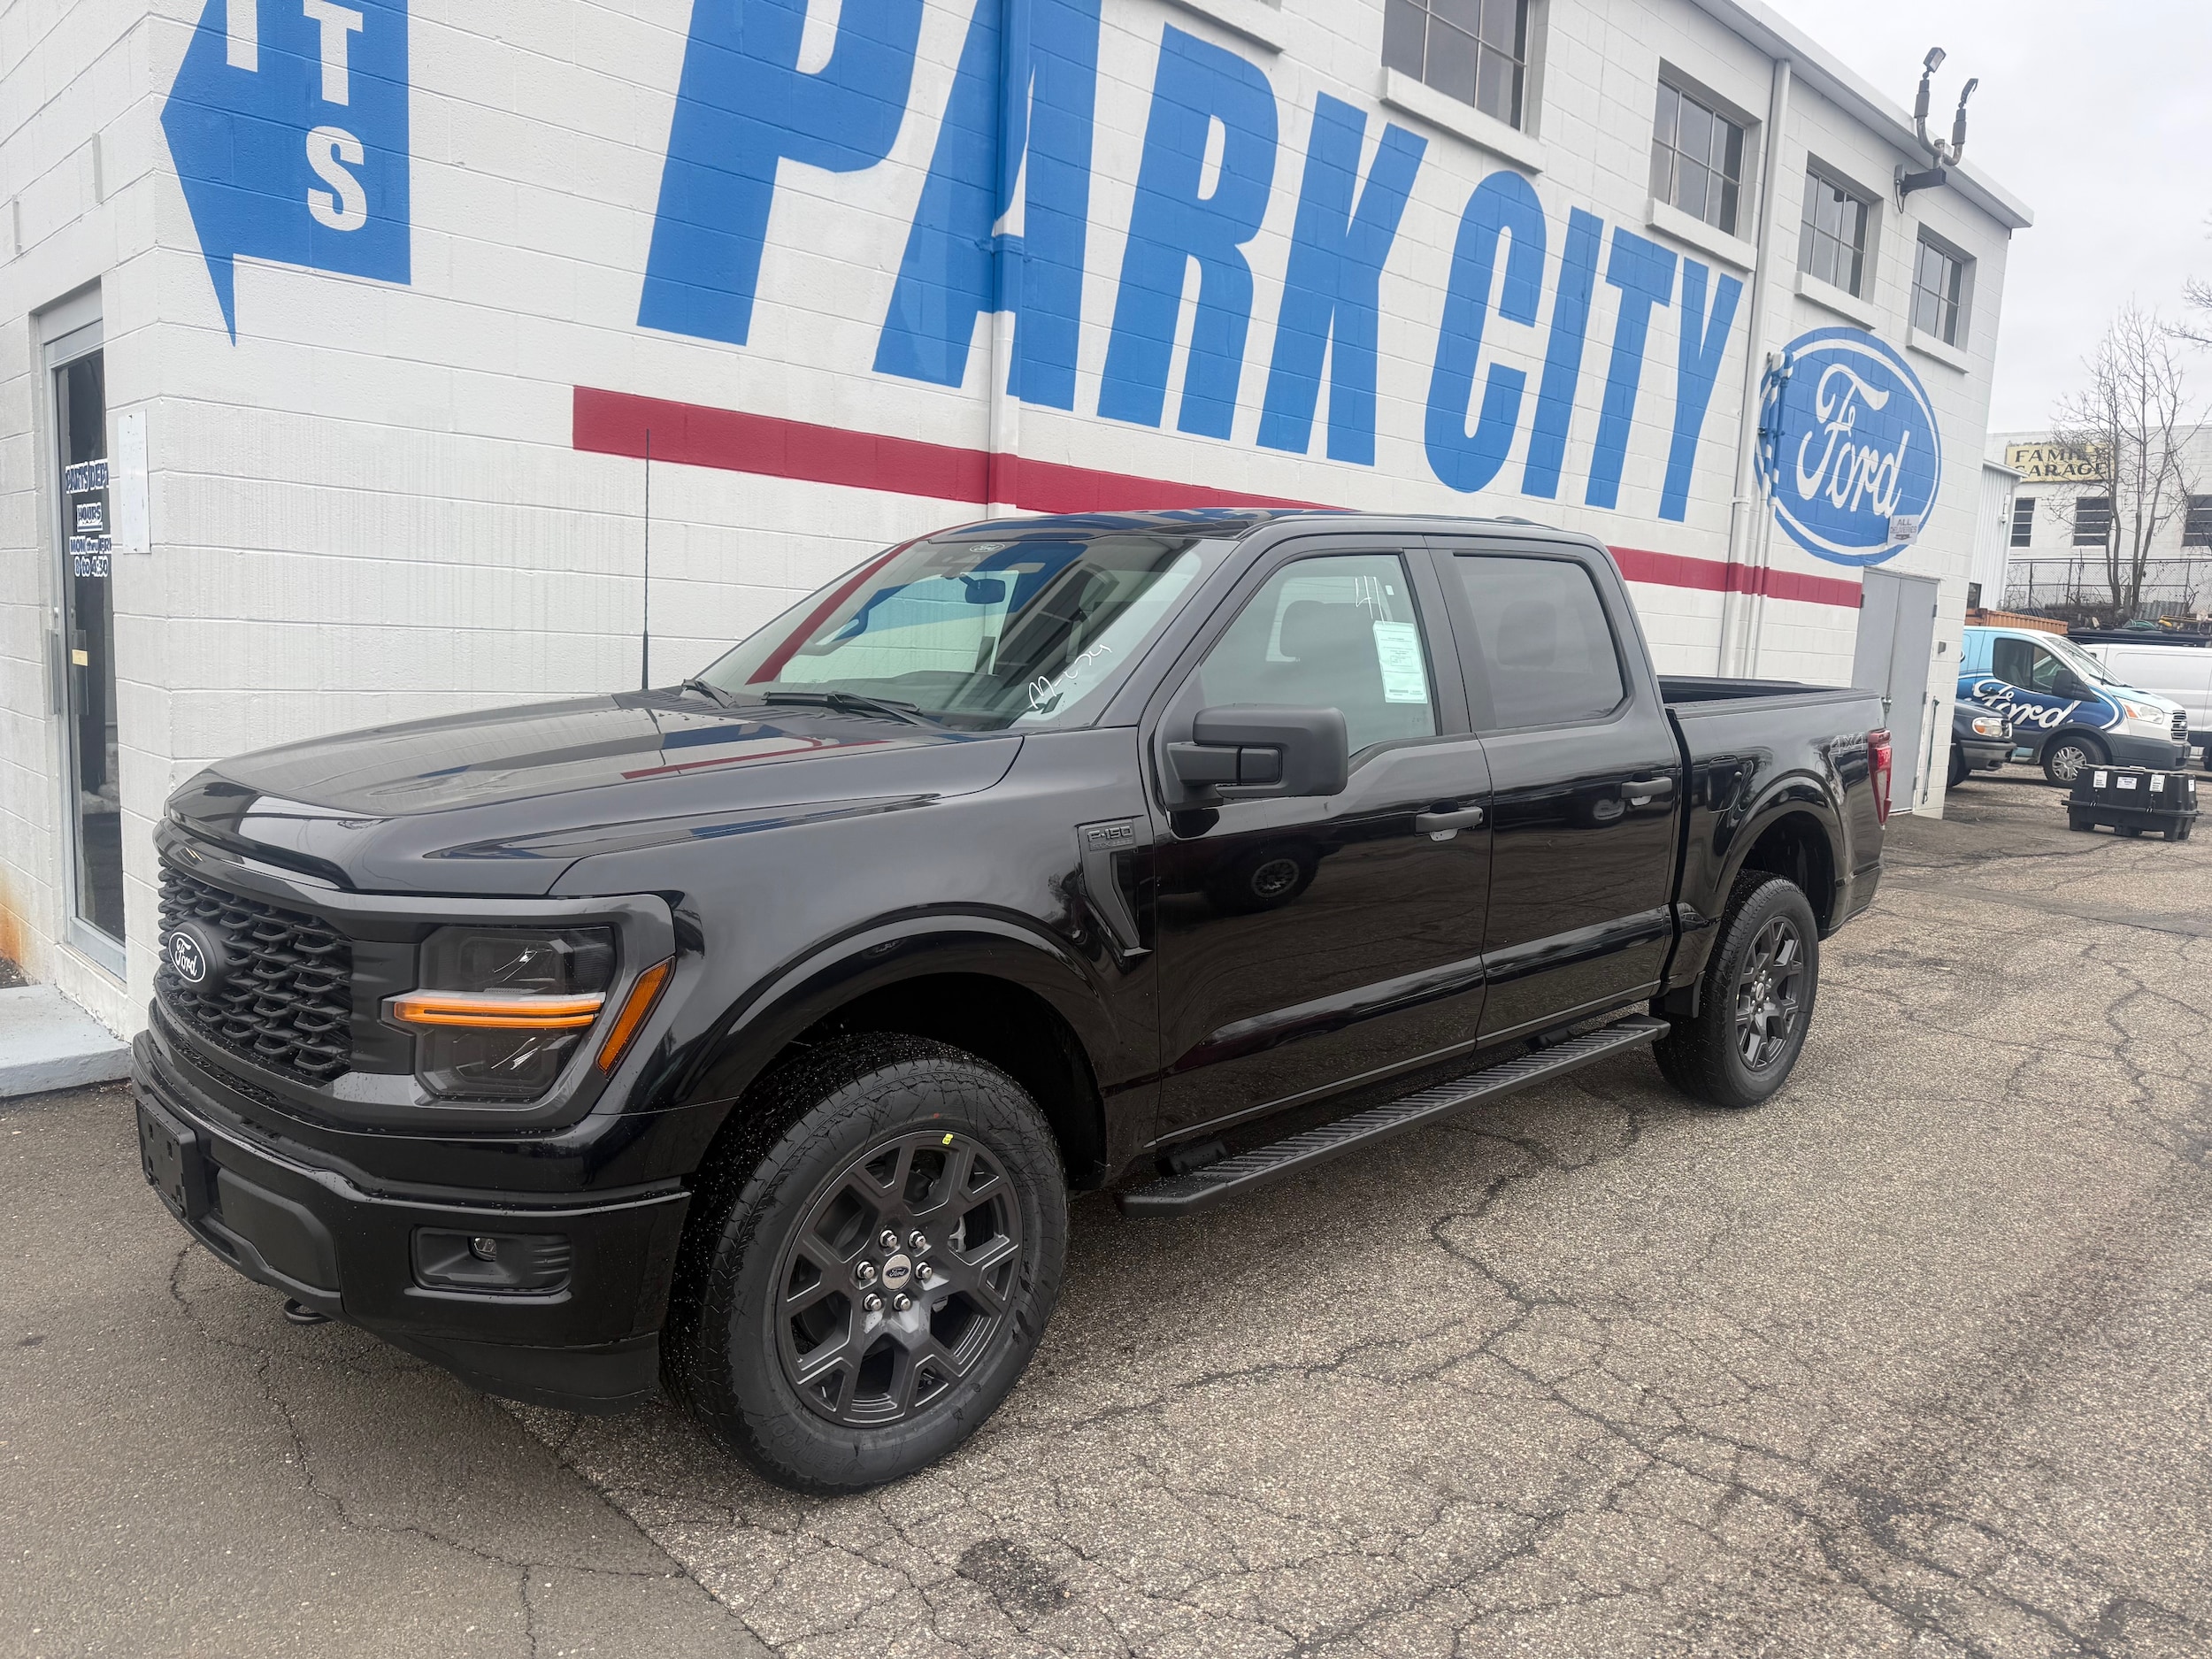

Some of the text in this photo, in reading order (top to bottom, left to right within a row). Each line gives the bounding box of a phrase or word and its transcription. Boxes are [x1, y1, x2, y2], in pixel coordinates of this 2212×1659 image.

[636, 0, 1743, 522] PARK CITY
[1796, 364, 1910, 518] Ford
[77, 503, 102, 526] HOURS
[70, 535, 86, 555] MON
[74, 556, 81, 577] 8
[81, 556, 90, 577] to
[1972, 679, 2082, 728] Ford
[1087, 826, 1133, 842] F-150
[174, 937, 199, 977] Ford
[889, 1268, 906, 1278] Ford
